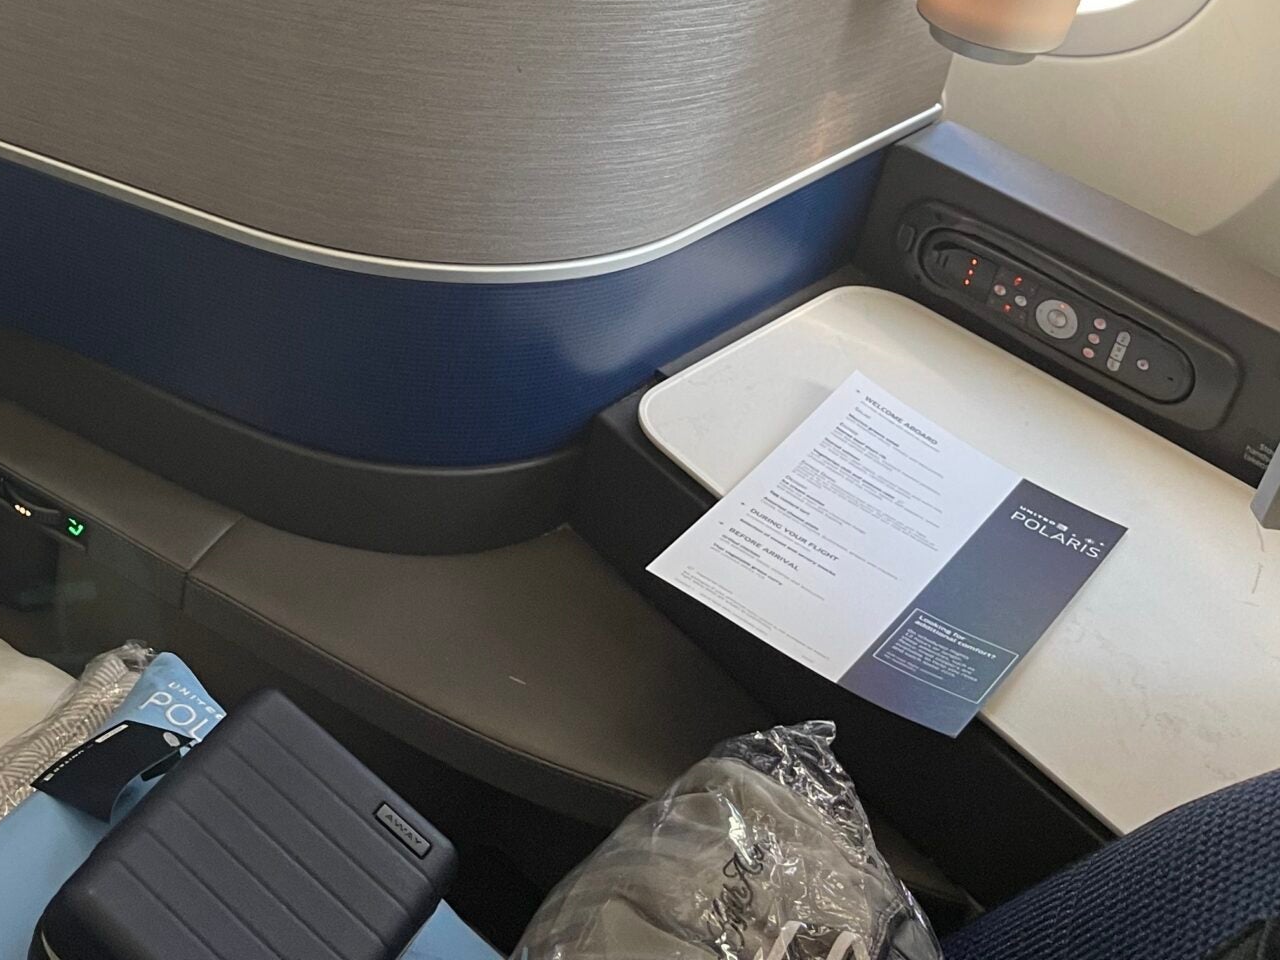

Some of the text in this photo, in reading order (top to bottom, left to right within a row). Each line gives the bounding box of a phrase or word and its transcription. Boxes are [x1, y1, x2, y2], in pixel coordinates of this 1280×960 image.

[865, 396, 904, 424] WELCOME
[904, 422, 938, 446] ABOARD
[729, 527, 762, 549] BEFORE
[763, 548, 800, 572] ARRIVAL
[750, 508, 783, 529] DURING
[785, 527, 808, 544] YOUR
[808, 542, 839, 562] FLIGHT
[1011, 511, 1100, 558] POLARIS
[914, 620, 958, 643] additional
[957, 640, 996, 660] comfort?
[919, 615, 967, 641] Looking for
[384, 814, 422, 844] AWAY
